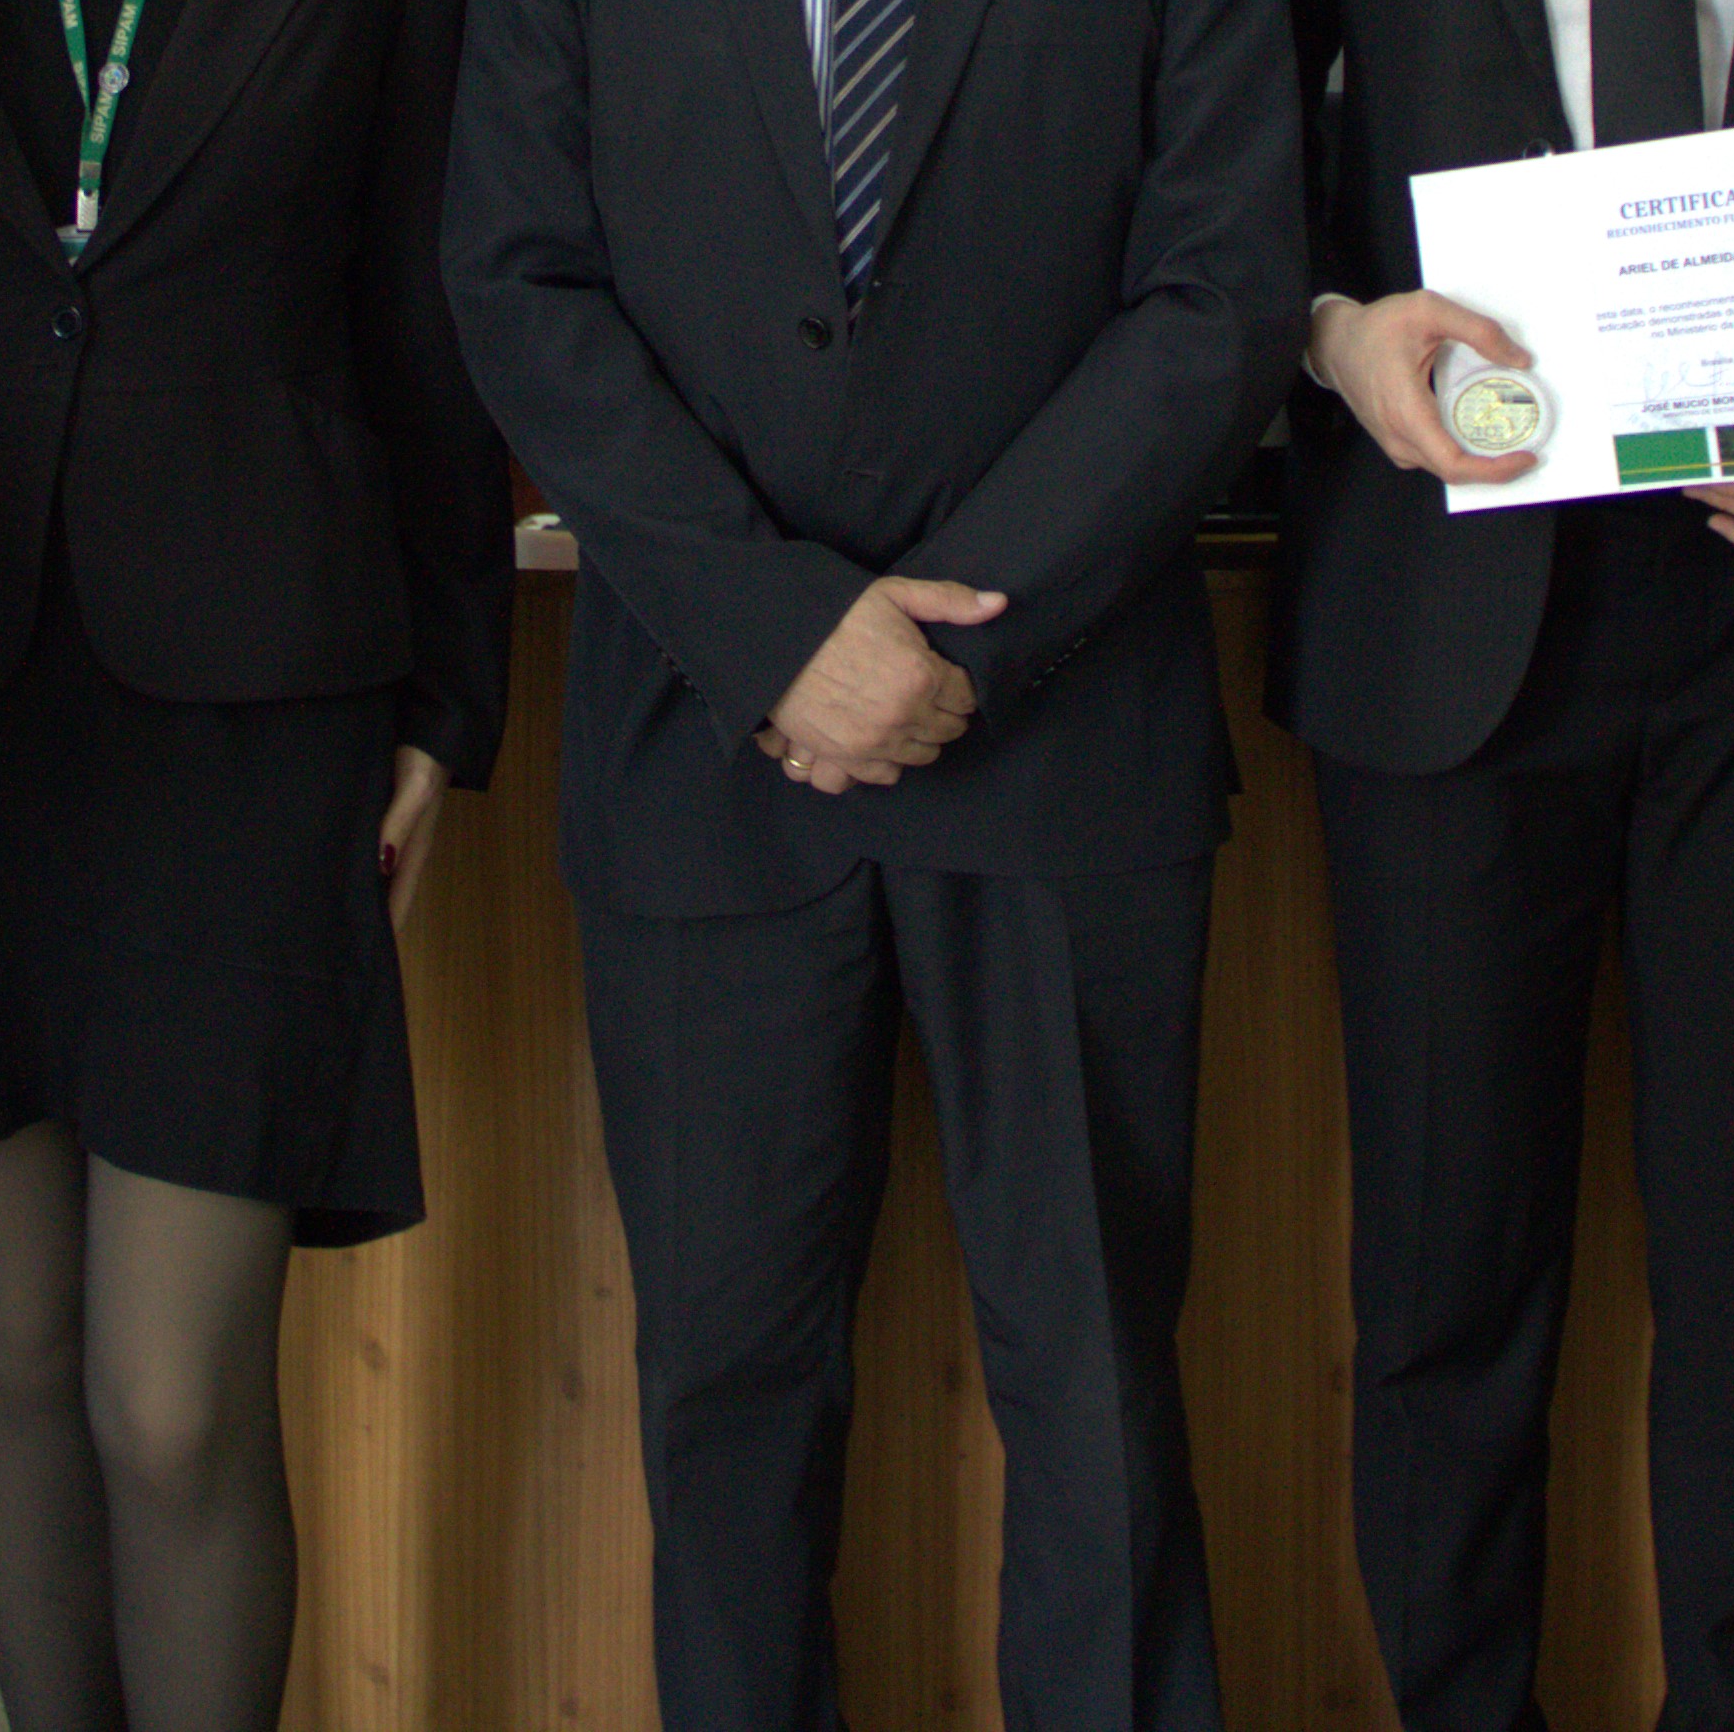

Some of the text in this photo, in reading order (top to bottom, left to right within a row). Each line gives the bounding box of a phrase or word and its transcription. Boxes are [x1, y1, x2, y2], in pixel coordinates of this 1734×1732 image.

[112, 3, 138, 56] SIPAM
[1607, 216, 1720, 238] RECONHECIMENTO
[1619, 262, 1658, 276] ARIEL
[1661, 259, 1680, 271] DE
[1641, 399, 1669, 413] JOSÉ
[1673, 397, 1709, 410] MUCIO
